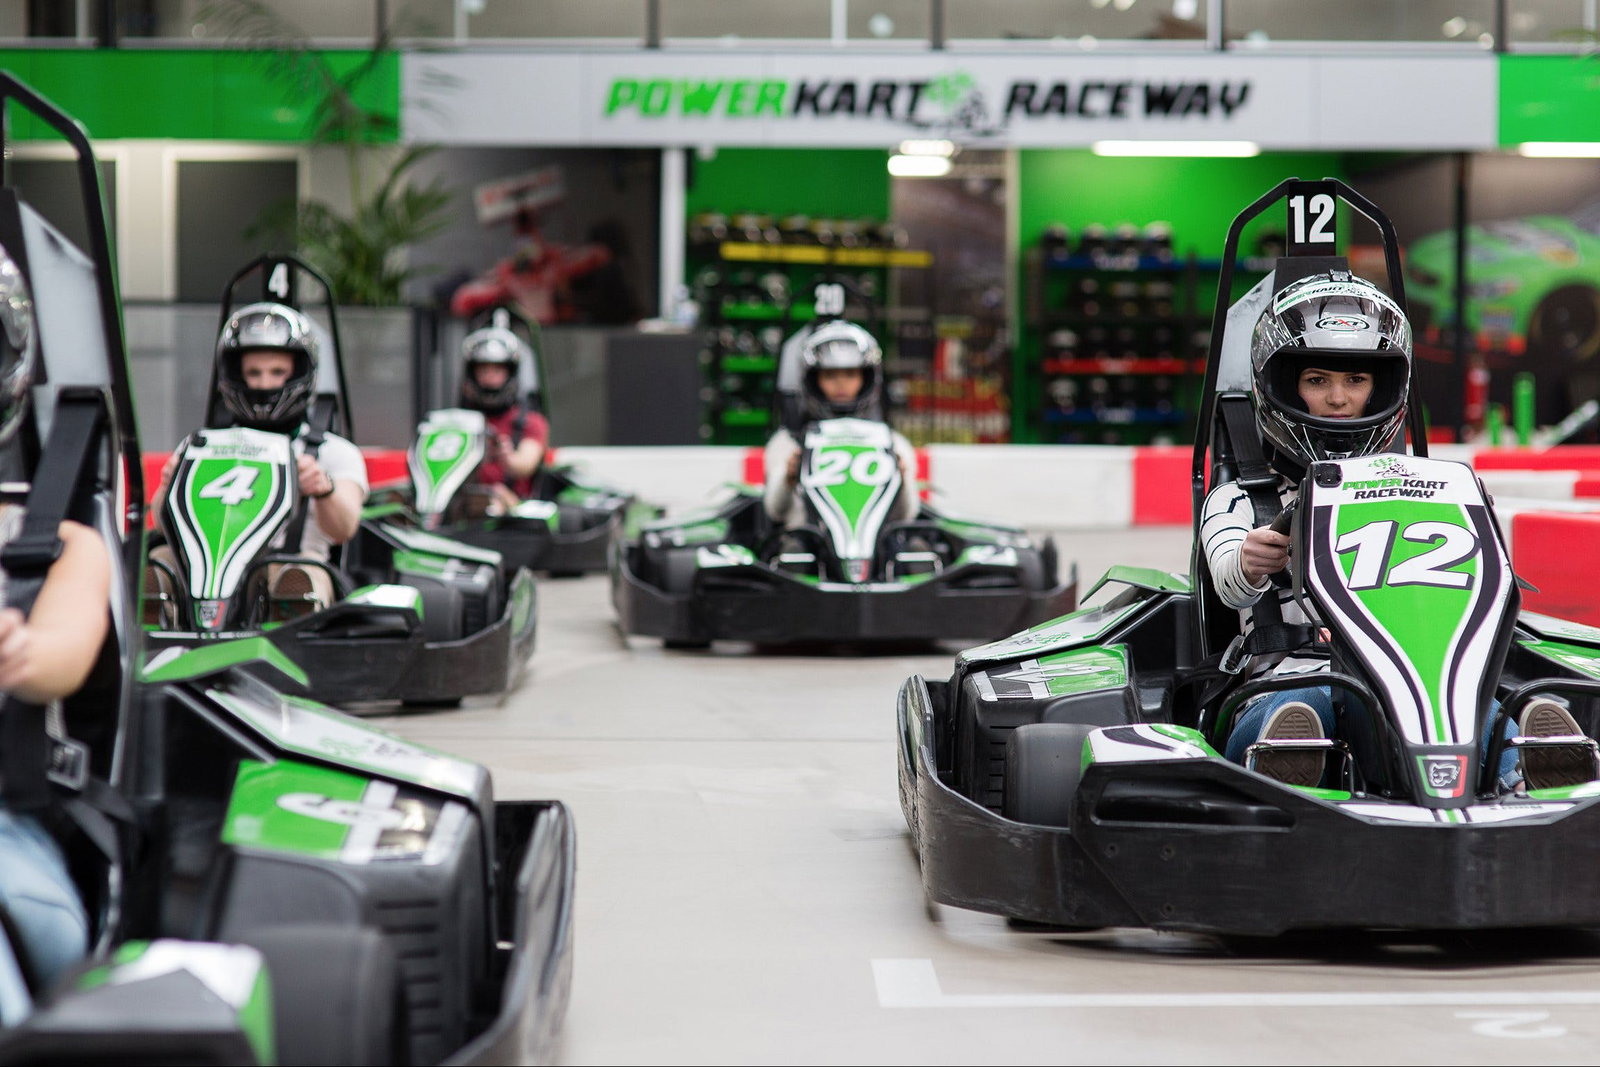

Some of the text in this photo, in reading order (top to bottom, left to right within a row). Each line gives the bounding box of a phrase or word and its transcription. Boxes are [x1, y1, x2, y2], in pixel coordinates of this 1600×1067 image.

[605, 78, 1251, 119] POWERKART RACEWAY
[1290, 193, 1335, 243] 12
[268, 262, 290, 298] 4
[199, 465, 260, 504] 4
[816, 448, 897, 487] 20
[1342, 477, 1448, 491] POWERKART
[1354, 487, 1436, 500] RACEWAY
[1335, 520, 1482, 592] 12
